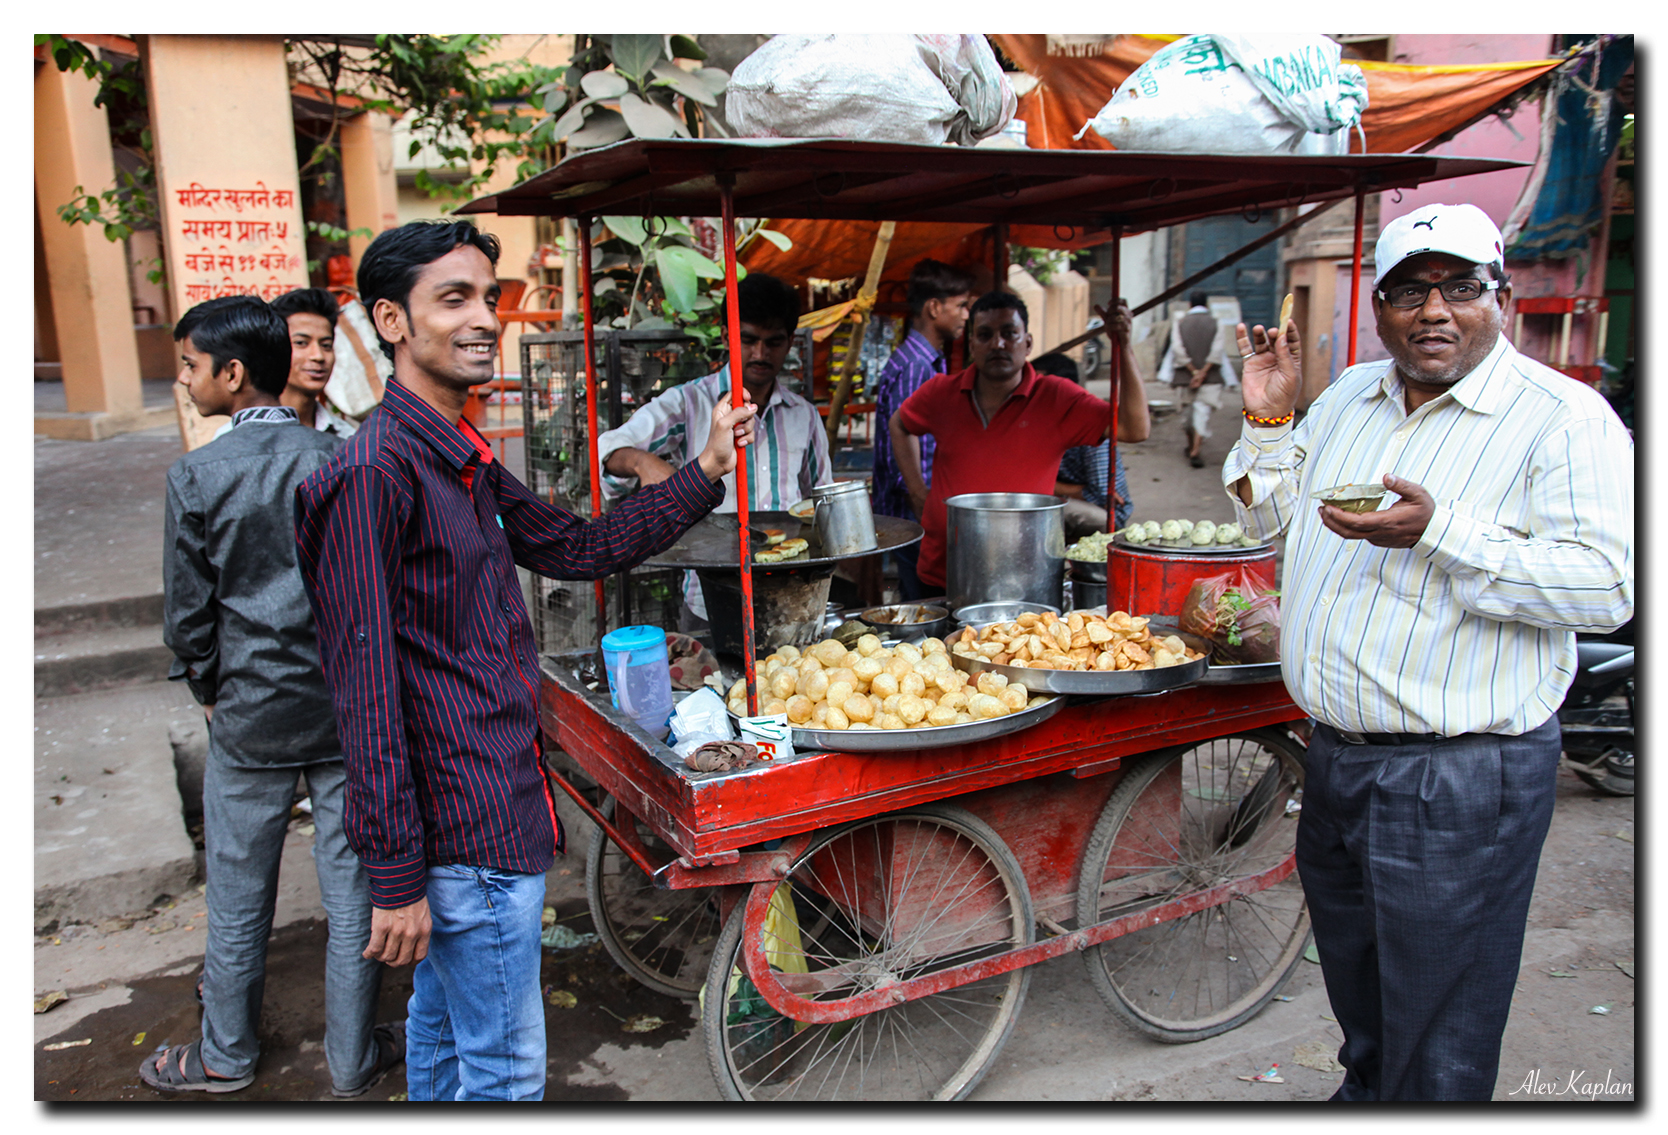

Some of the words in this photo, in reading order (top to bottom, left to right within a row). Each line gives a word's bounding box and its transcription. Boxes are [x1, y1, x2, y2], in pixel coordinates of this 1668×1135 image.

[272, 190, 294, 209] का
[182, 220, 232, 242] समय
[185, 246, 215, 272] बजे
[218, 245, 235, 274] से
[259, 245, 287, 272] बजे
